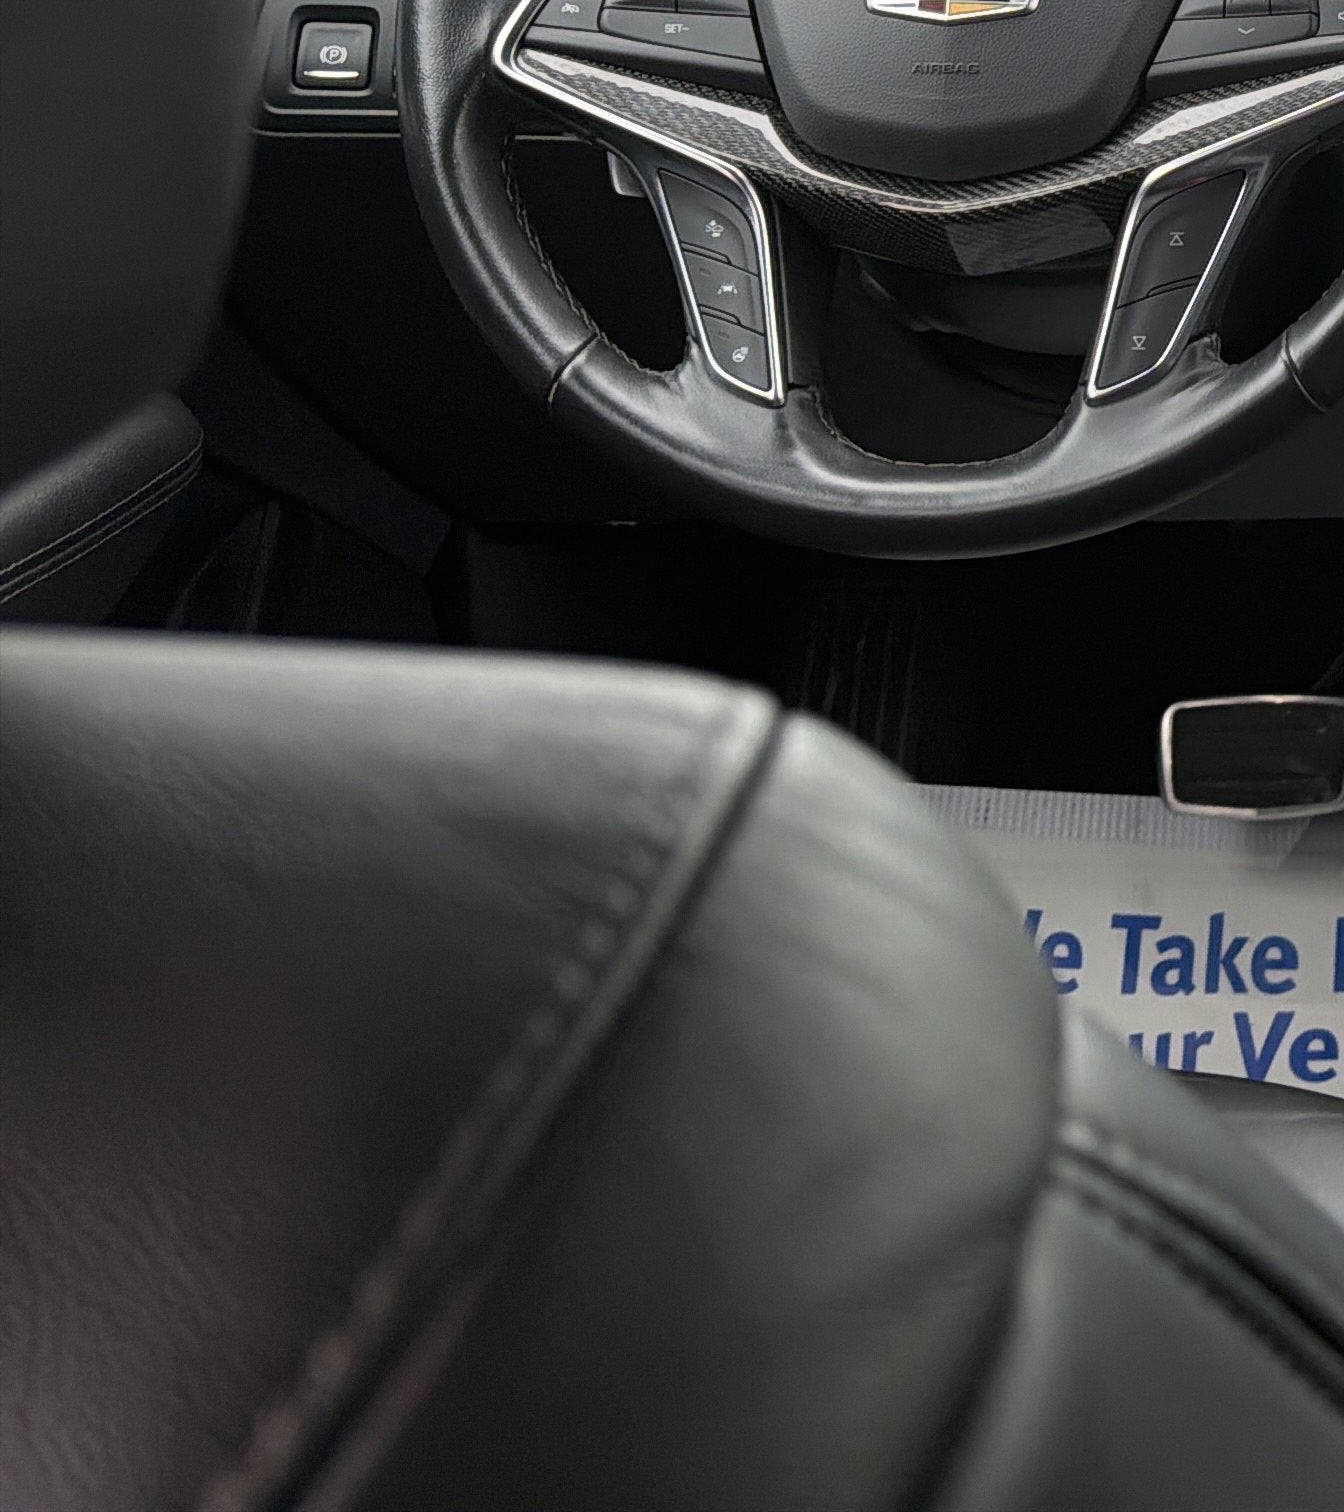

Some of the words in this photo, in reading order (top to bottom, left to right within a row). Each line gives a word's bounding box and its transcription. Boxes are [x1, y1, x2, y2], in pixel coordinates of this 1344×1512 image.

[911, 62, 981, 77] AIRBAG
[1021, 908, 1083, 990] e
[1110, 911, 1301, 996] Take
[1125, 1026, 1214, 1076] ur
